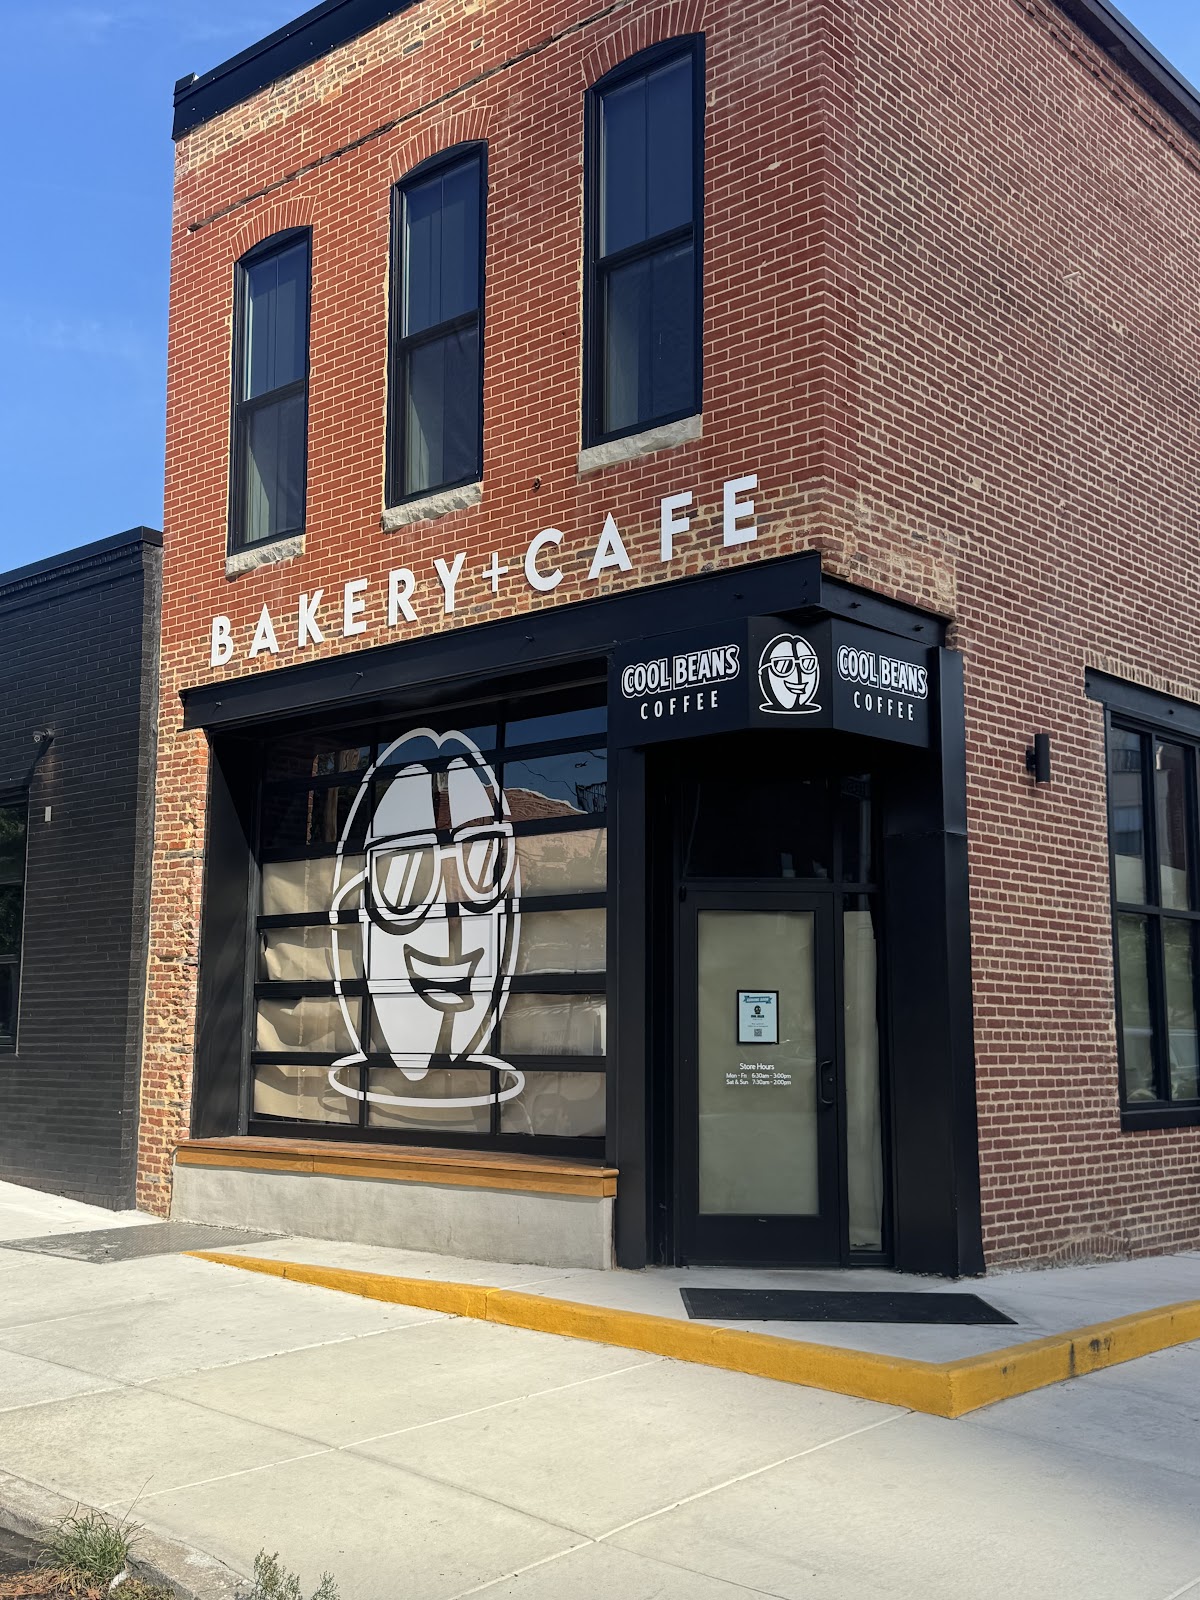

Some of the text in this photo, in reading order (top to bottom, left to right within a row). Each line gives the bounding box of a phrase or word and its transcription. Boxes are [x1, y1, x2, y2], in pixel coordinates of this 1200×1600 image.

[622, 644, 740, 699] COOL BEANS
[836, 644, 929, 700] COOL BEANS
[640, 690, 718, 720] COFFEE
[853, 691, 914, 721] COFFEE
